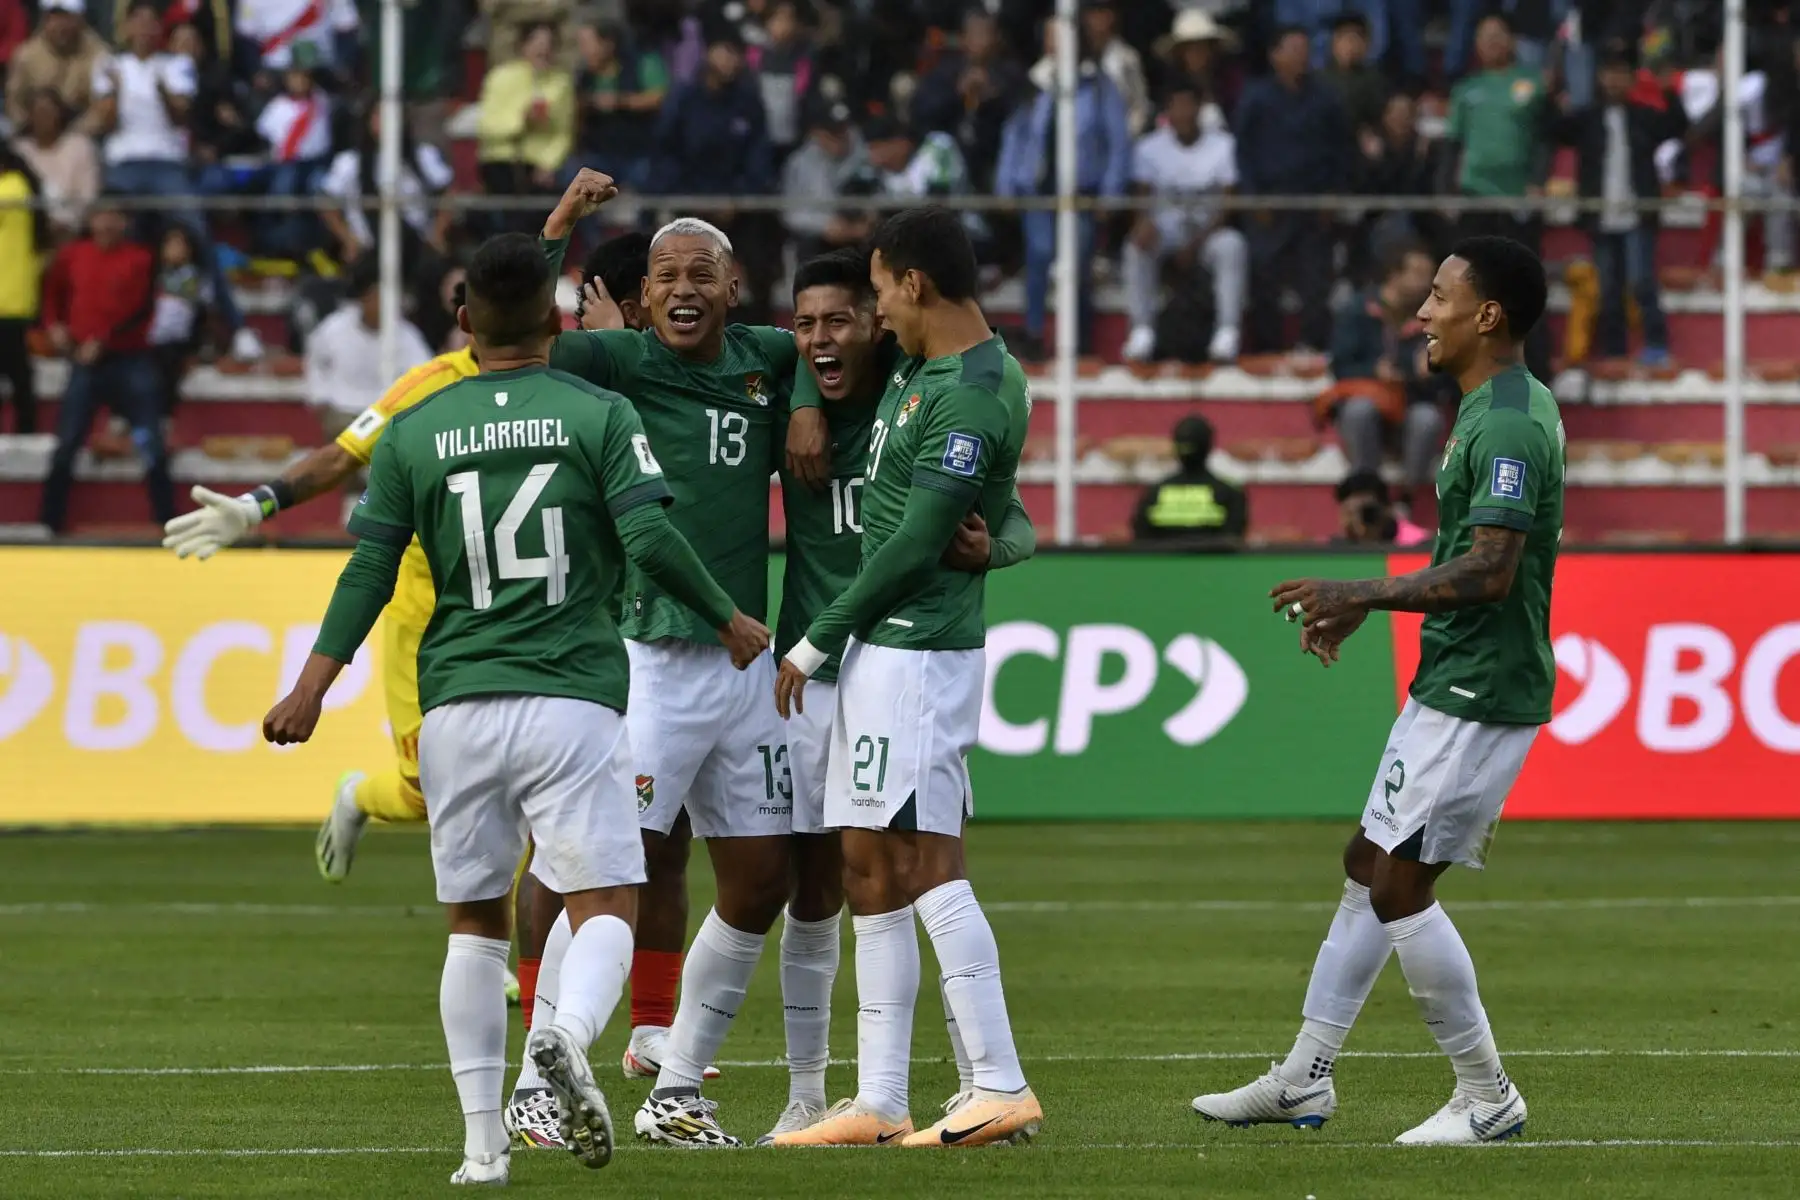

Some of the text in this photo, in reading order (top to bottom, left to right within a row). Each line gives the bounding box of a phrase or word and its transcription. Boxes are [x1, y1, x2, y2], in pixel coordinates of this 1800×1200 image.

[435, 418, 570, 460] VILLARROEL
[705, 408, 749, 466] 13
[446, 463, 570, 610] 14
[853, 734, 890, 793] 21
[1385, 759, 1405, 816] 2
